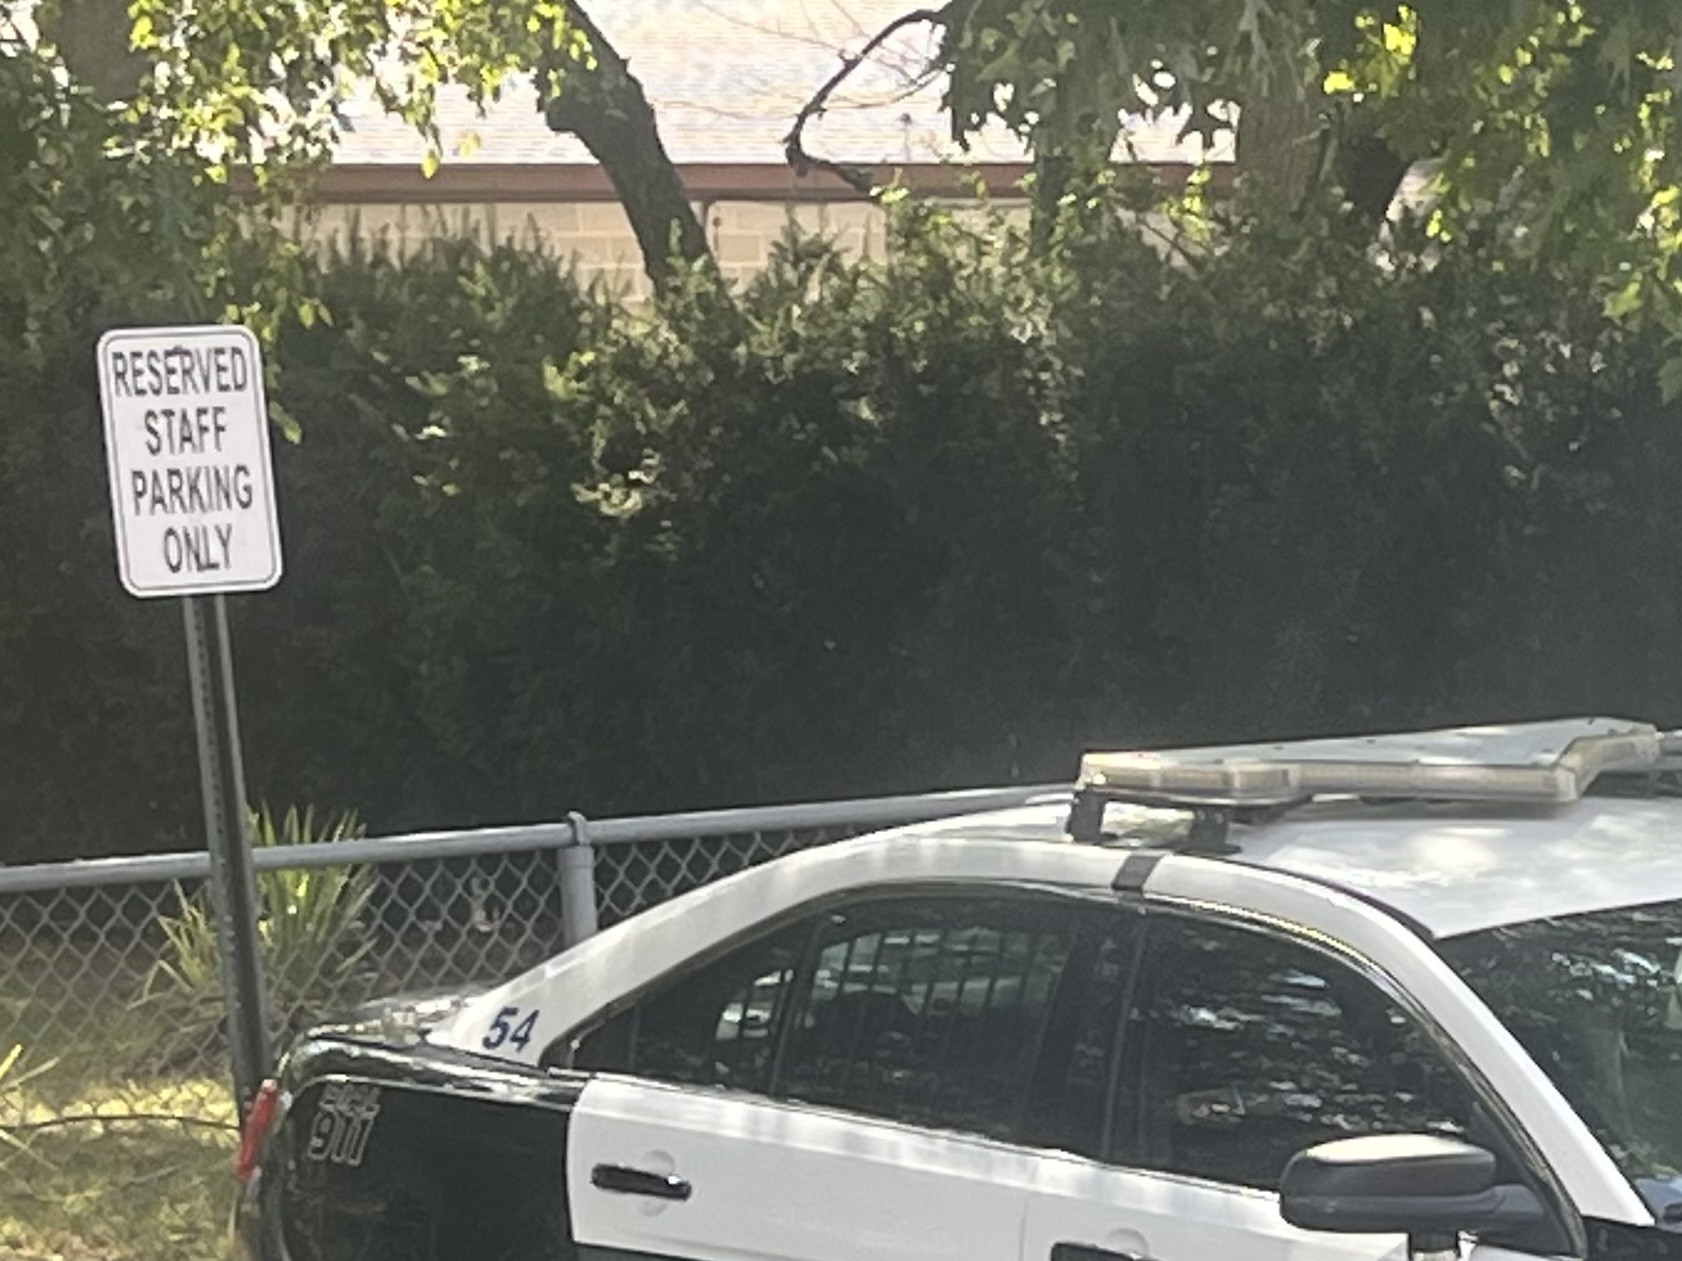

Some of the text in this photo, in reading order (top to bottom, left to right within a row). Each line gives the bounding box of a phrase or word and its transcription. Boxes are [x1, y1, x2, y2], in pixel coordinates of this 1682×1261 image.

[112, 346, 248, 397] RESERVED
[144, 406, 226, 456] STAFF
[131, 464, 253, 516] PARKING
[163, 523, 233, 574] ONLY
[482, 1006, 540, 1053] 54
[307, 1103, 375, 1166] 911
